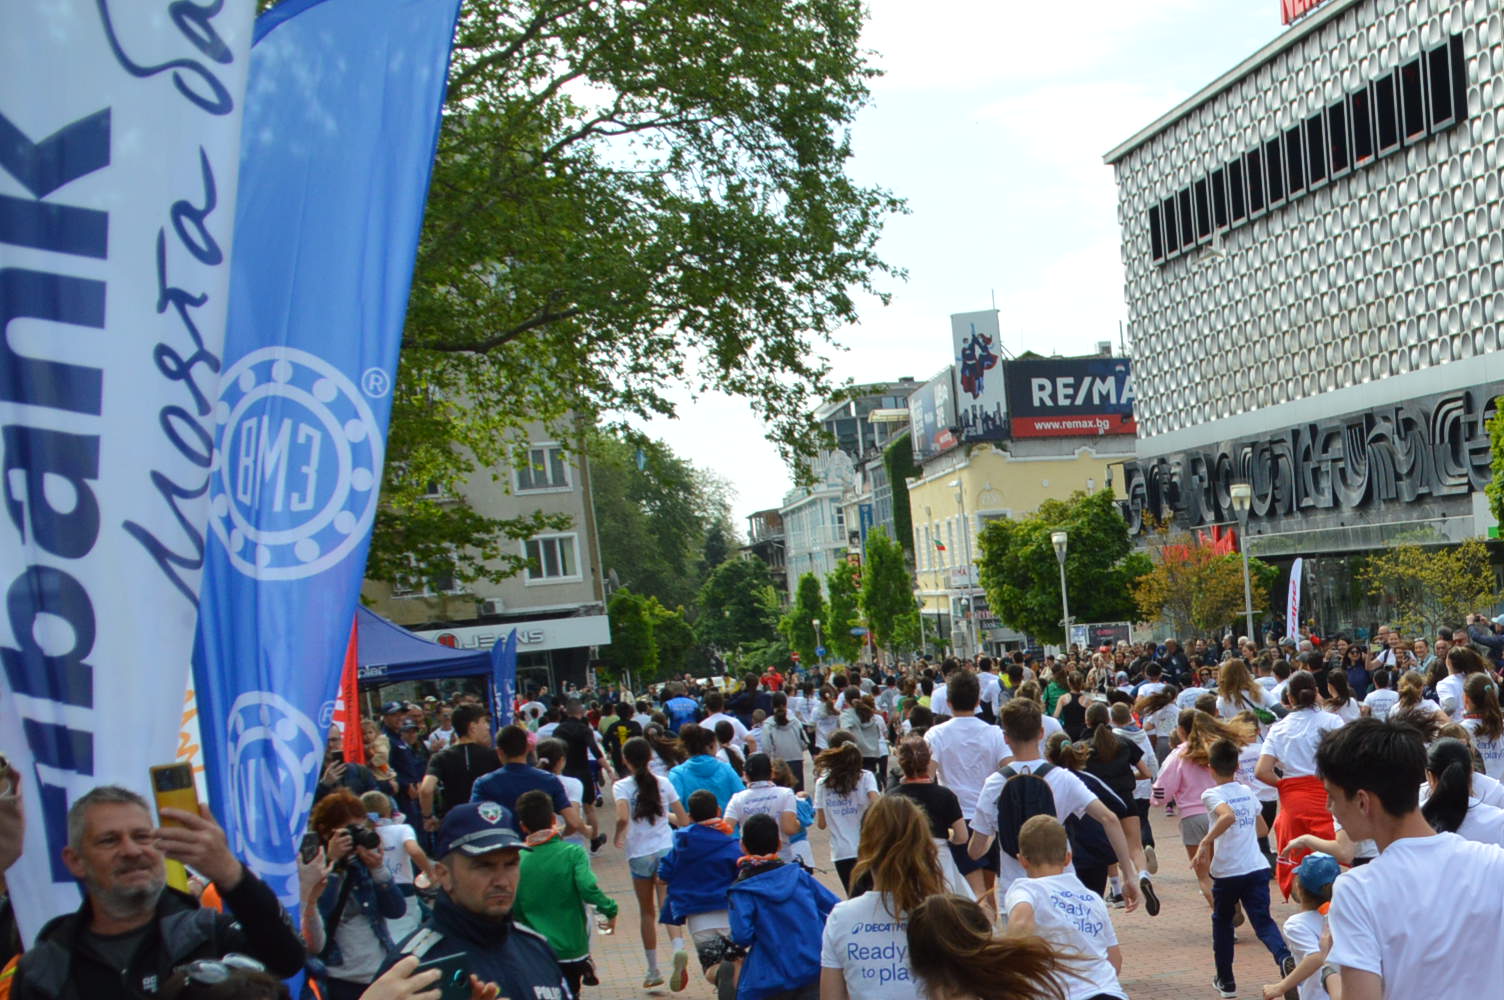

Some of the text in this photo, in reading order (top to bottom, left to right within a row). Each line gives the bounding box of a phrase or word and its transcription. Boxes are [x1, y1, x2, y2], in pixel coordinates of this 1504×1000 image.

[1034, 418, 1110, 432] www.remax.bg
[463, 630, 545, 649] JENS
[848, 942, 908, 962] Ready
[862, 965, 918, 985] to pla
